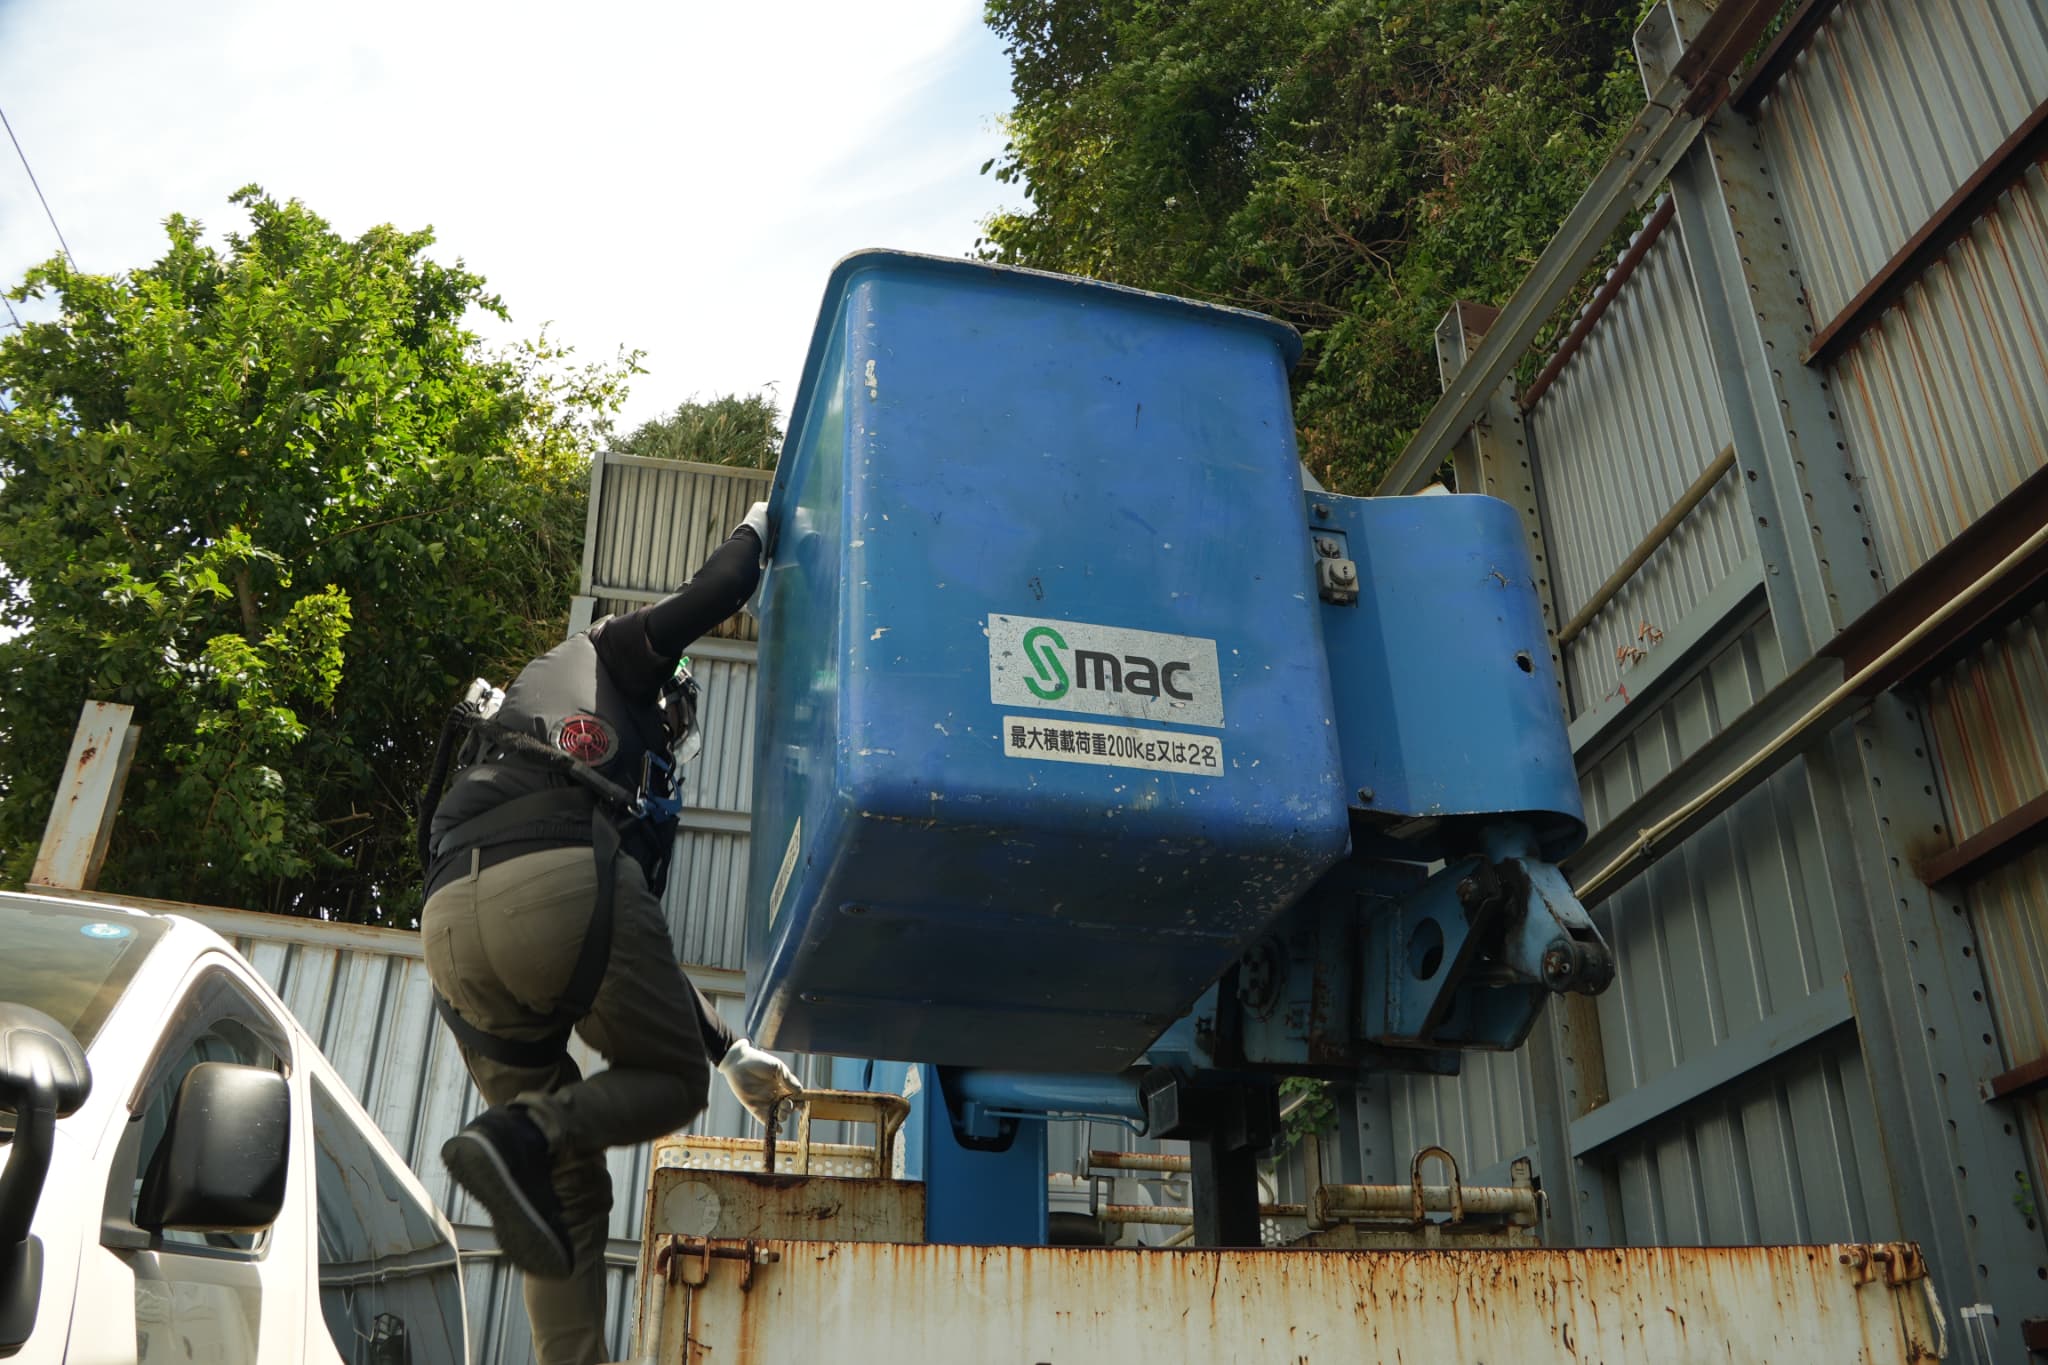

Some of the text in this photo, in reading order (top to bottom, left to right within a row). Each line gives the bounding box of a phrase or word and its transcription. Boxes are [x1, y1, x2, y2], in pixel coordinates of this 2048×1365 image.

[1011, 725, 1217, 768] 最大積載荷重200kg又は2名
